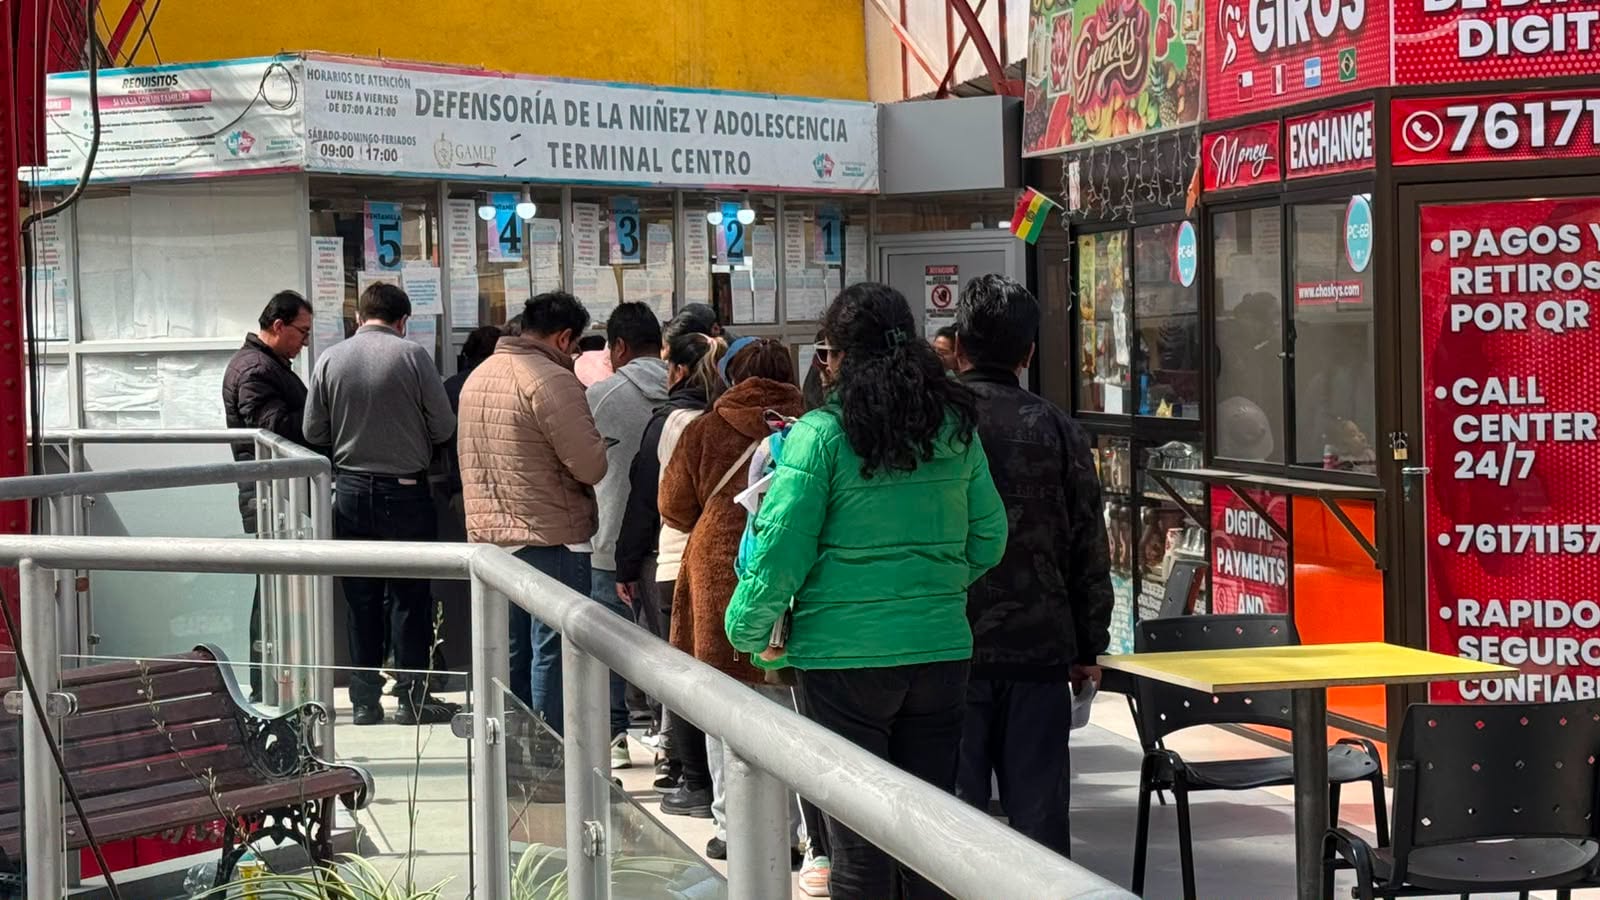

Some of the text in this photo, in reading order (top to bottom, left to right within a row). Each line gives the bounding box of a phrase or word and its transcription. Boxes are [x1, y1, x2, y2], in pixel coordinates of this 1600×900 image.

[1457, 11, 1599, 58] DIGIT
[1074, 15, 1142, 104] Genesis
[122, 75, 178, 89] REQUISITOS
[307, 69, 411, 90] HORARIOS DE ATENCIÓN
[325, 90, 399, 105] LUNES A VIERNES
[329, 103, 397, 117] DE 07:00 A 21:00
[415, 88, 848, 143] DEFENSORÍA DE LA NIÑEZ Y ADOLESCENCIA
[320, 143, 398, 162] 09:00 17:00
[456, 144, 497, 161] GAMLP
[1289, 110, 1373, 170] EXCHANGE
[547, 141, 751, 176] TERMINAL CENTRO
[1211, 135, 1274, 187] Money
[378, 220, 402, 267] 5
[498, 211, 522, 254] 4
[618, 215, 639, 256] 3
[727, 220, 744, 258] 2
[822, 221, 834, 255] 1
[1449, 224, 1581, 258] PAGOS
[1298, 283, 1360, 300] www.chaskys.com
[1450, 260, 1600, 296] RETIROS
[1451, 300, 1590, 333] POR QR
[1452, 376, 1546, 406] CALL
[1453, 412, 1597, 443] CENTER
[1454, 442, 1536, 486] 24/7
[1455, 524, 1600, 553] 76171157
[1216, 547, 1286, 586] PAYMENTS
[1238, 592, 1264, 615] AND
[1457, 598, 1600, 629] RAPIDO
[1458, 635, 1600, 666] SEGURO
[1458, 674, 1600, 702] CONFIAB
